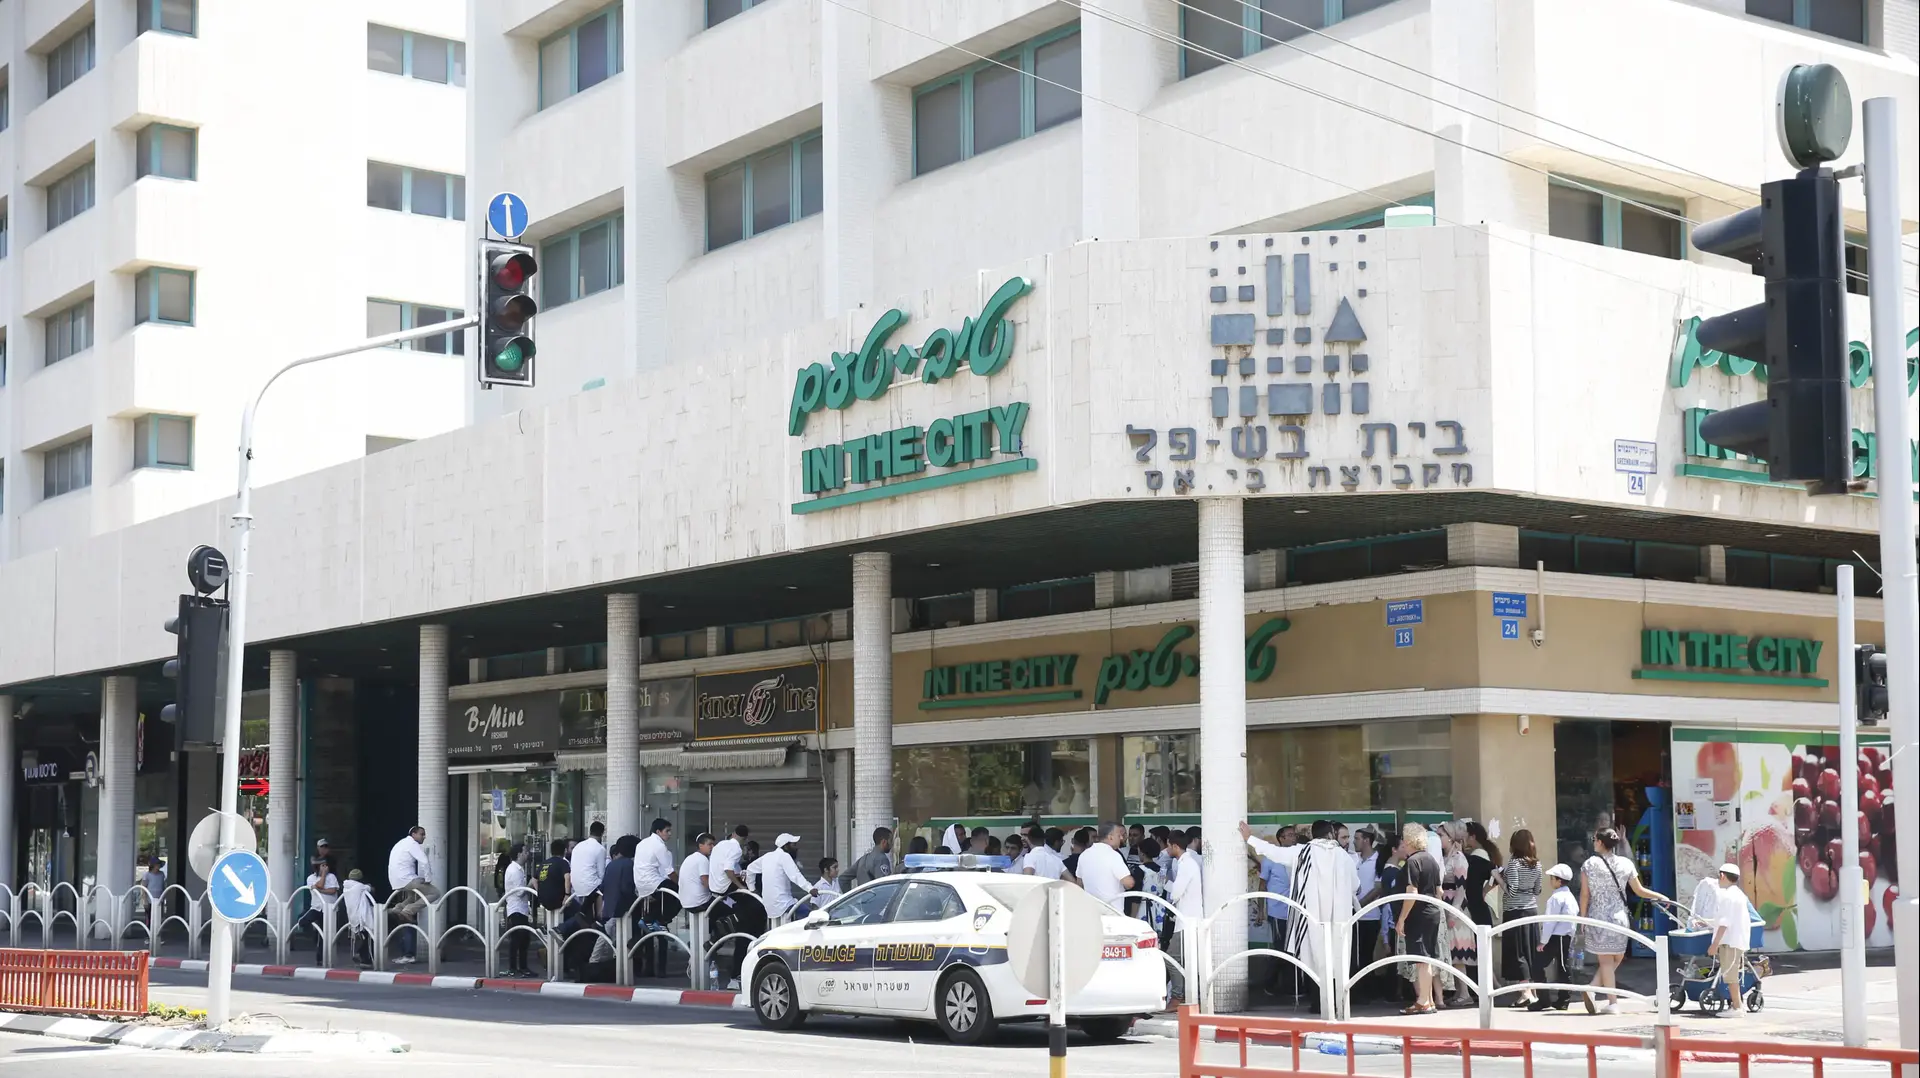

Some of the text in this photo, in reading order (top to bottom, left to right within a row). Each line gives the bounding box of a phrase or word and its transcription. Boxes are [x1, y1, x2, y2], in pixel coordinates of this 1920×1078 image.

[802, 402, 1030, 494] IN THE CITY
[1361, 420, 1469, 458] בית
[1308, 462, 1473, 488] מקבוצת
[1631, 475, 1643, 491] 24
[1398, 631, 1410, 644] 18
[1504, 623, 1517, 636] 24
[1641, 629, 1824, 674] IN THE CITY
[923, 654, 1079, 699] IN THE CITY
[465, 703, 524, 737] B-Mine
[801, 944, 856, 962] POLICE
[876, 943, 936, 961] משטרה
[843, 980, 910, 991] משטרת ישראל
